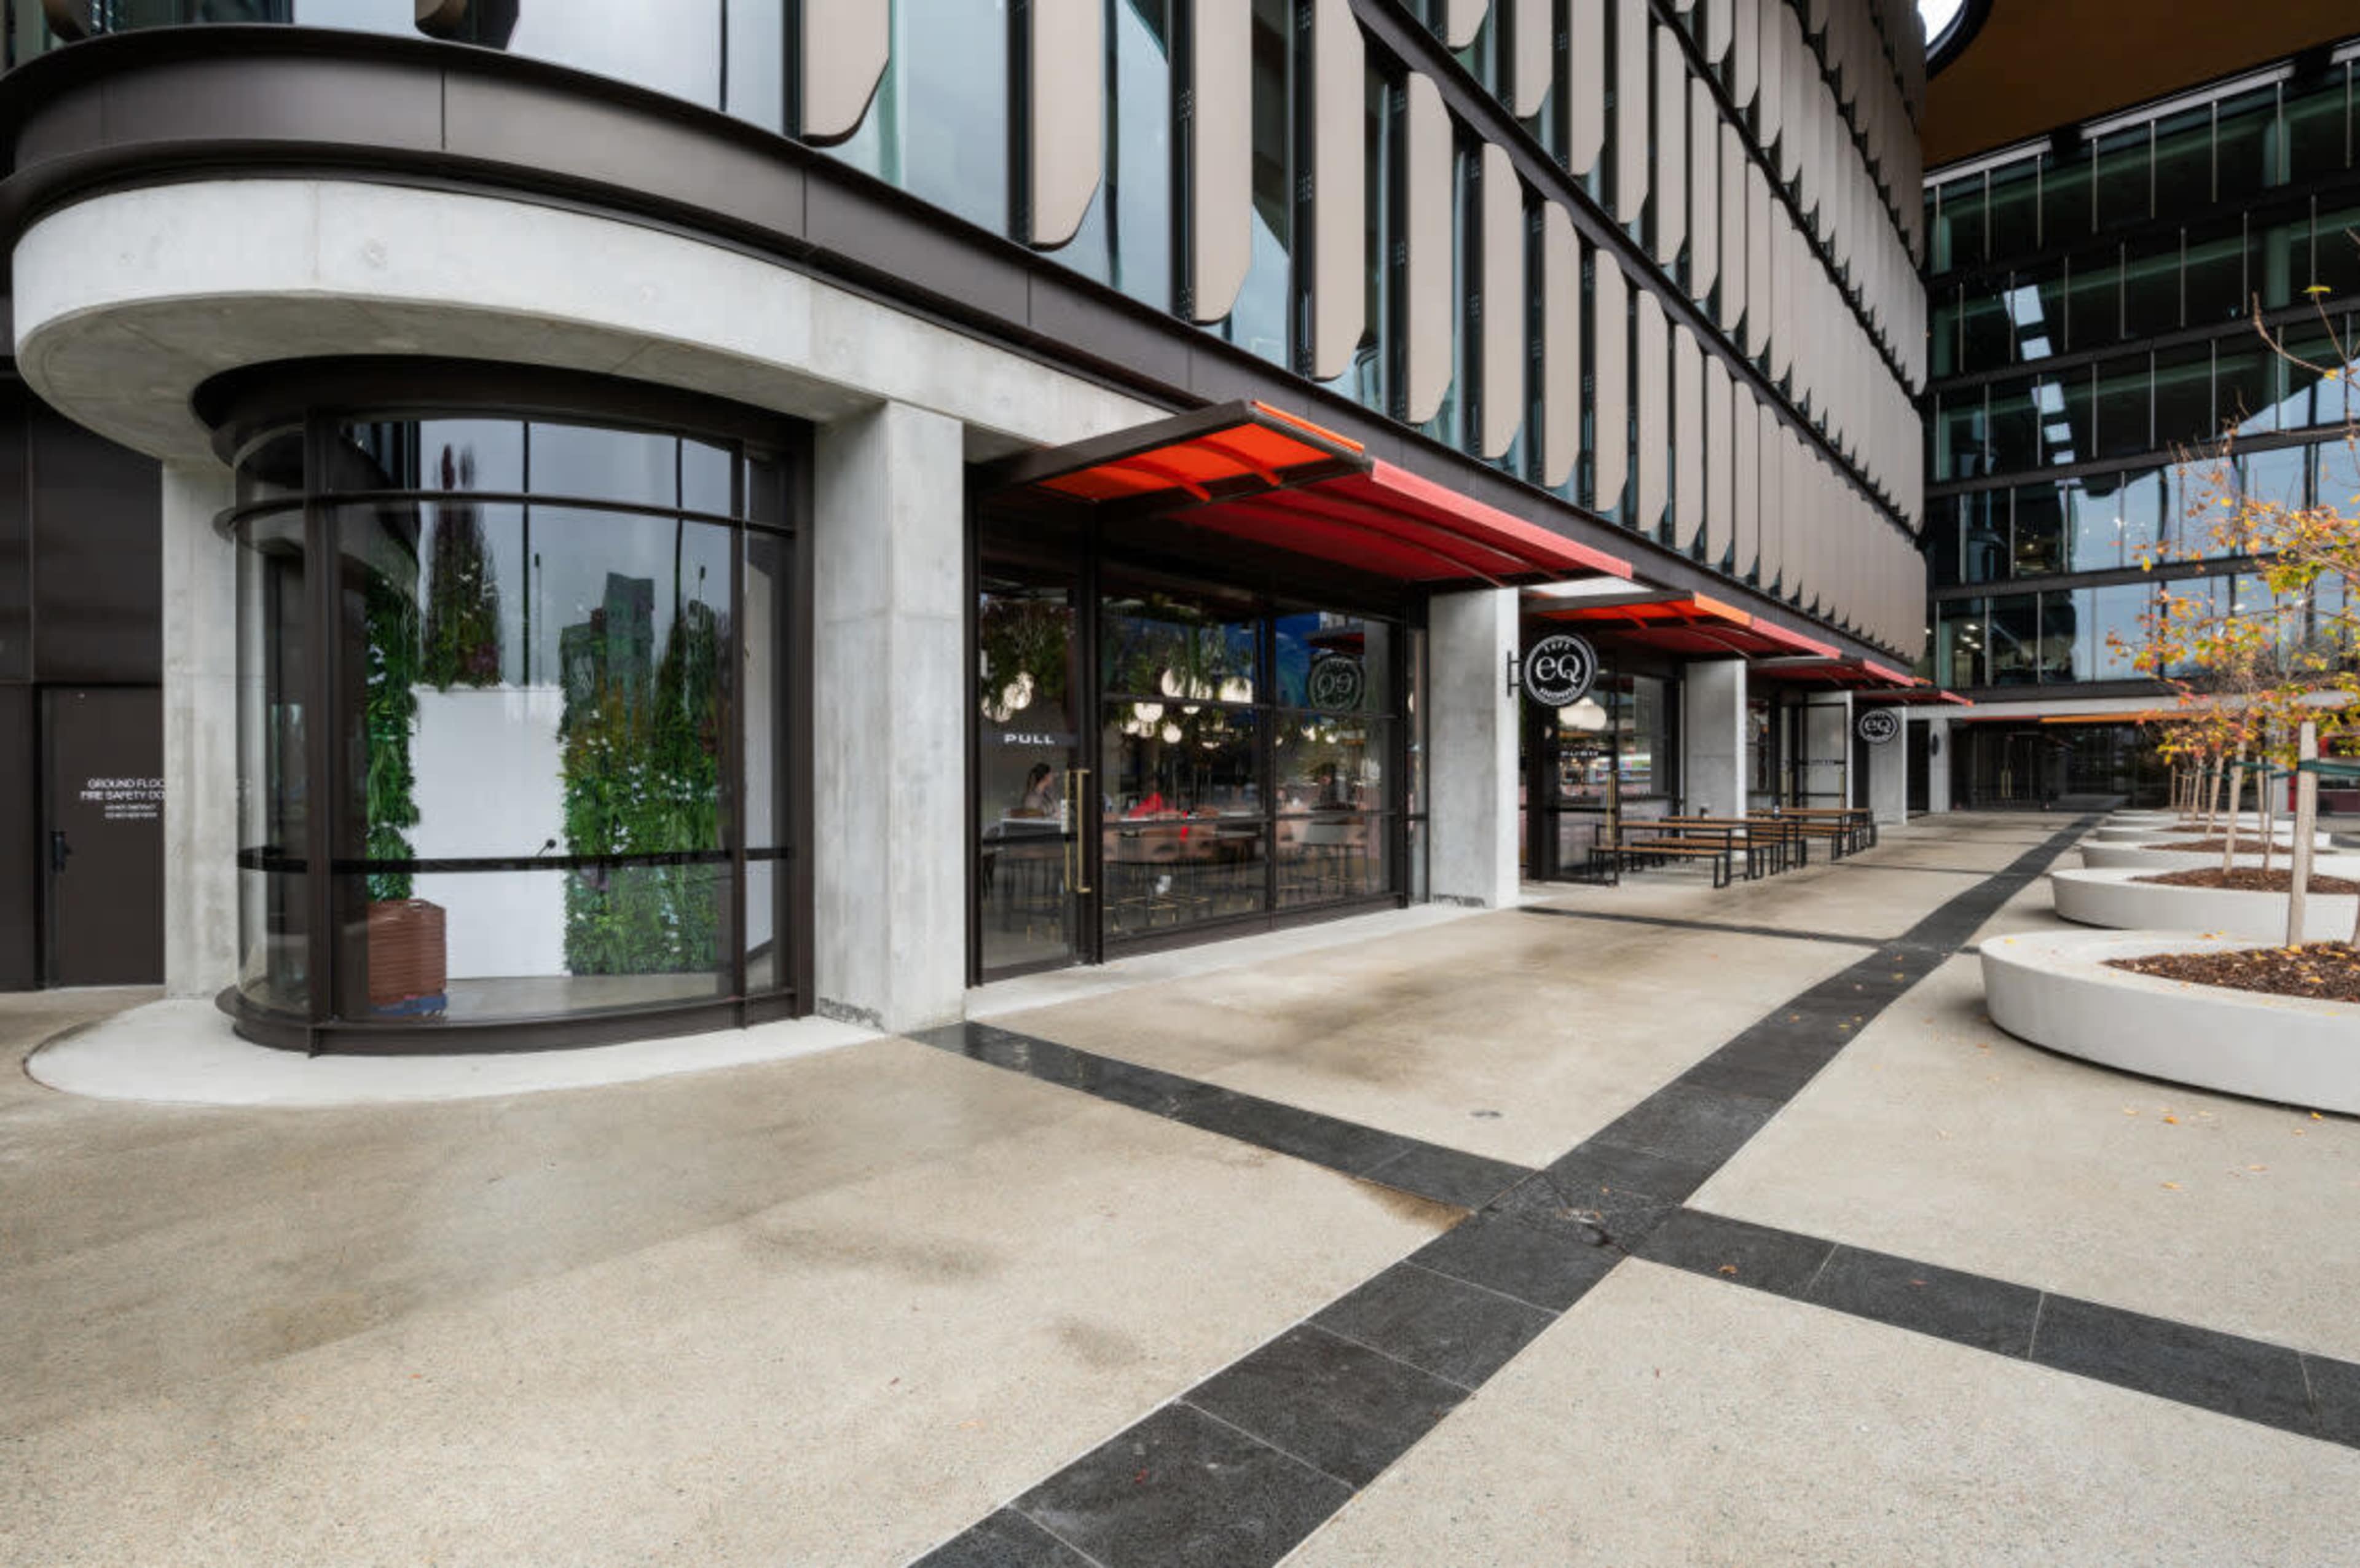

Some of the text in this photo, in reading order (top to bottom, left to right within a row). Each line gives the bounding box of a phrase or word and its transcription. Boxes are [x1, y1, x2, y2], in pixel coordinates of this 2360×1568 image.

[1536, 654, 1581, 683] eQ
[1004, 734, 1055, 744] PULL
[88, 778, 135, 789] GROUND
[80, 790, 103, 800] FIRE
[104, 790, 146, 800] SAFETY
